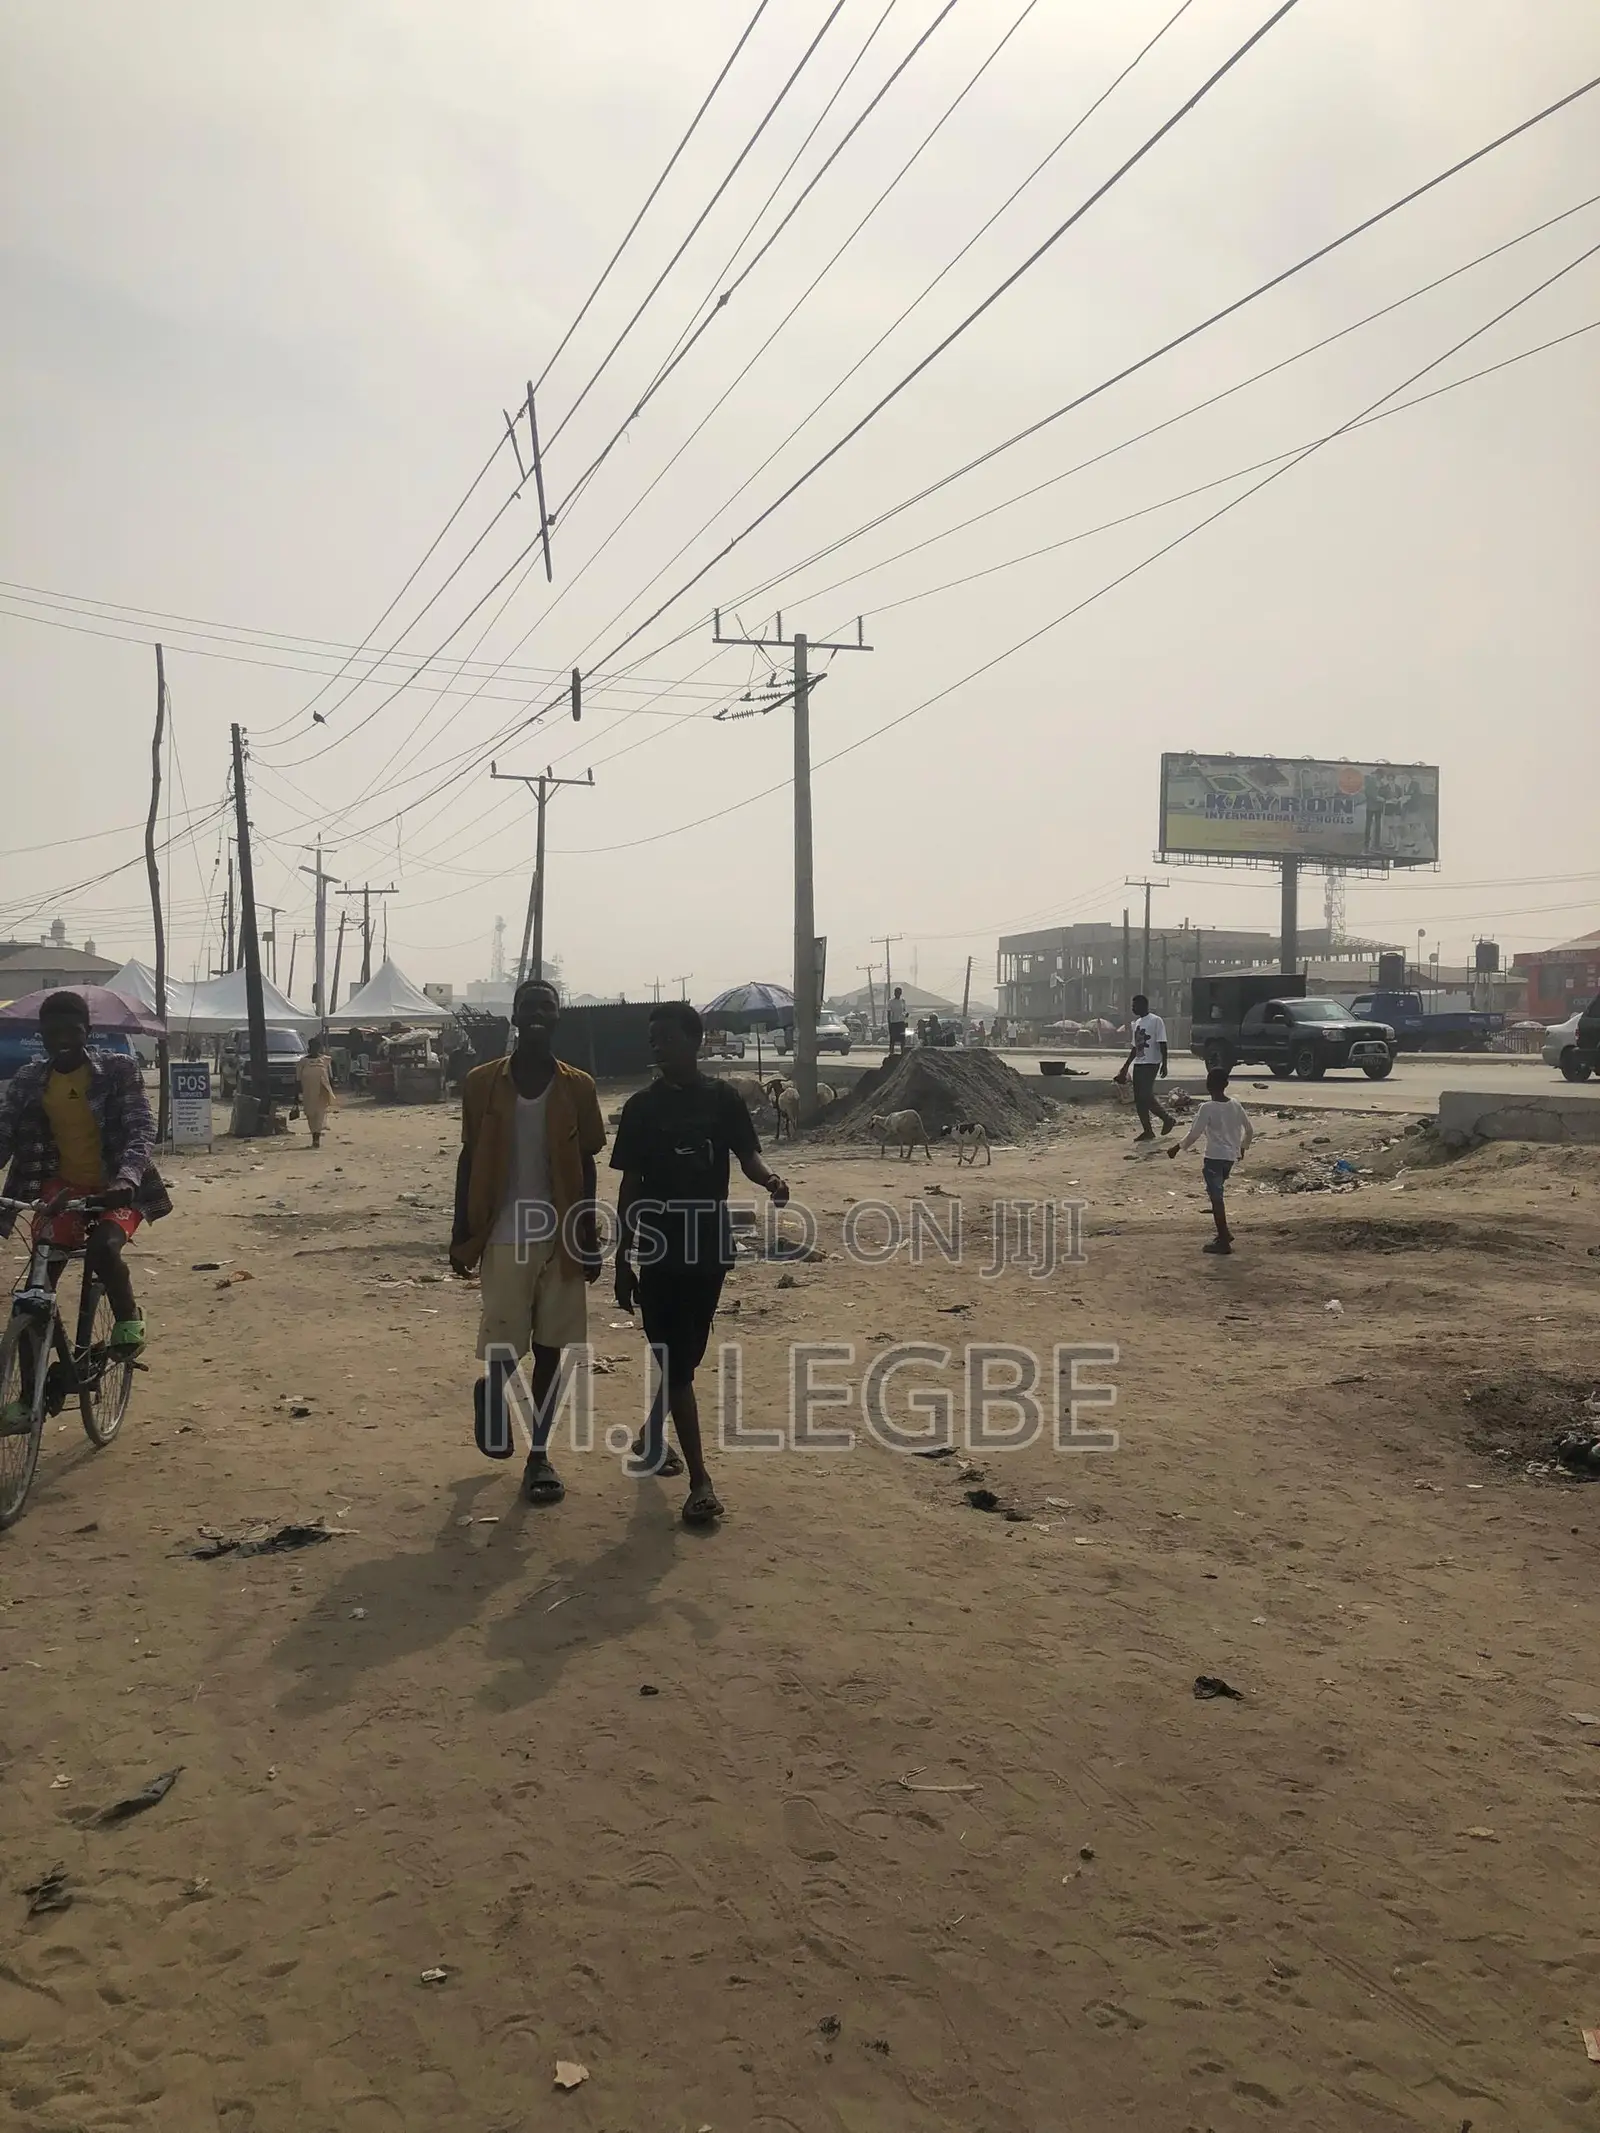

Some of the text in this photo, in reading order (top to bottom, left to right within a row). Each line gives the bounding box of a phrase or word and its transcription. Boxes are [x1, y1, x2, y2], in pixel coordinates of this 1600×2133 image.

[1204, 793, 1355, 814] KAYRON
[1204, 811, 1354, 824] INTERNATIONAL SCHOOLS
[177, 1075, 206, 1091] POS
